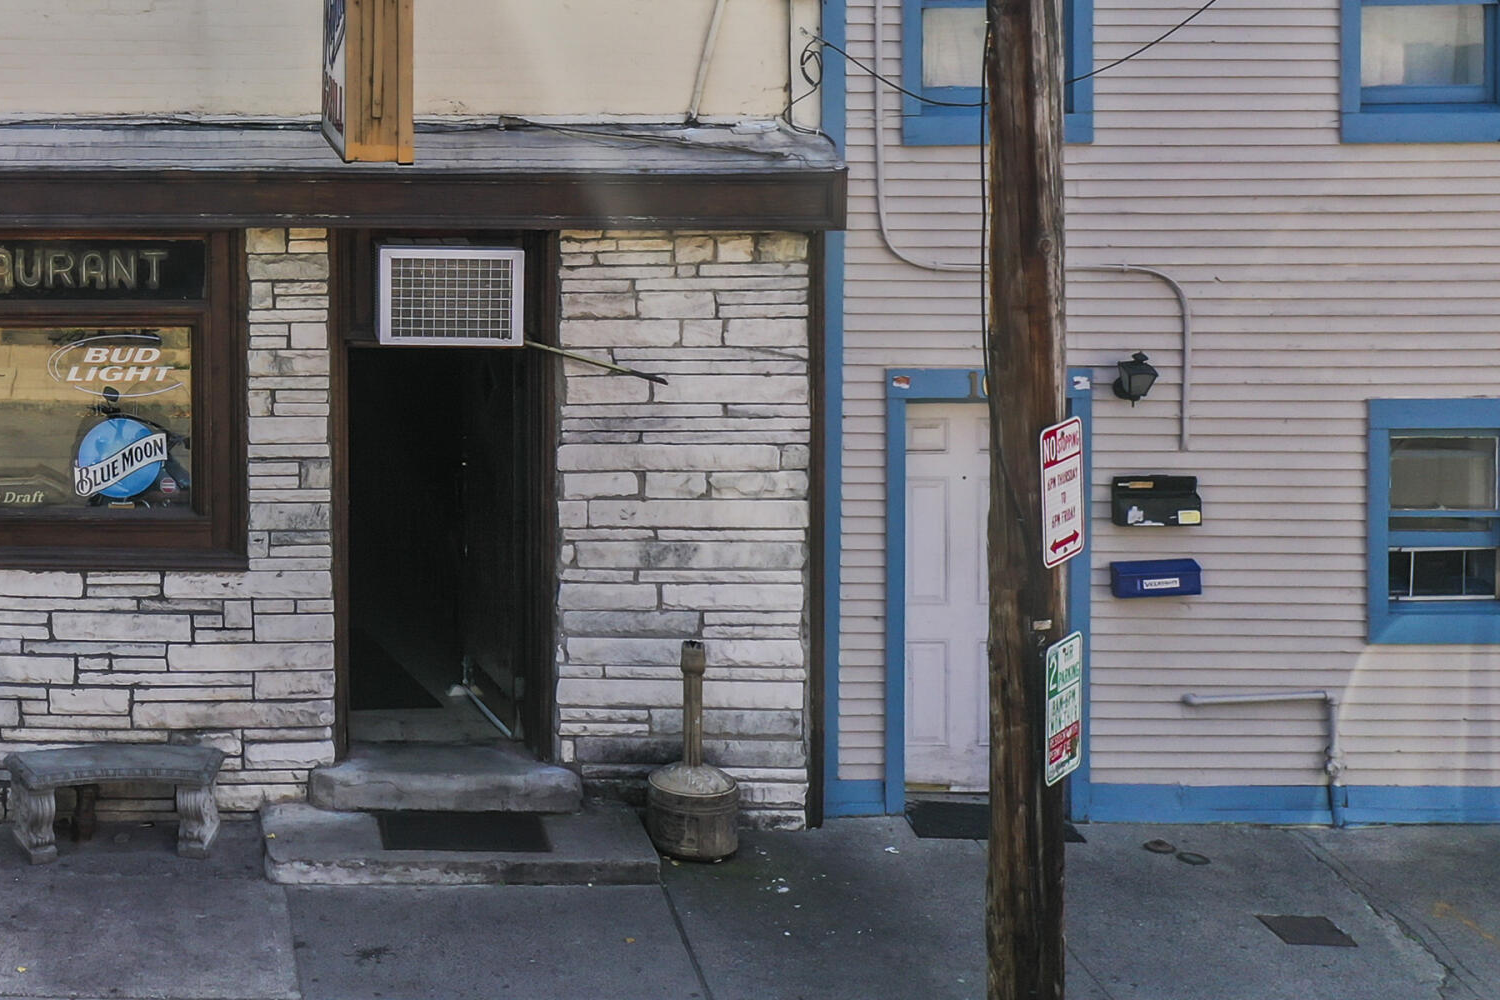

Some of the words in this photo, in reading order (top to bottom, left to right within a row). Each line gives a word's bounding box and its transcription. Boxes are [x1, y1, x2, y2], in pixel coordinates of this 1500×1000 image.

[83, 347, 161, 363] BUD
[66, 366, 175, 382] LIGHT
[1044, 436, 1056, 463] NO
[1057, 430, 1079, 455] STOPPING
[77, 459, 120, 495] BLUE
[122, 437, 164, 472] MOON
[1057, 467, 1078, 486] THURSDAY
[3, 491, 45, 503] Draft
[1061, 491, 1067, 504] TO
[1062, 506, 1076, 522] FRIDAY
[1049, 654, 1058, 691] 2
[1058, 662, 1080, 686] PARKING
